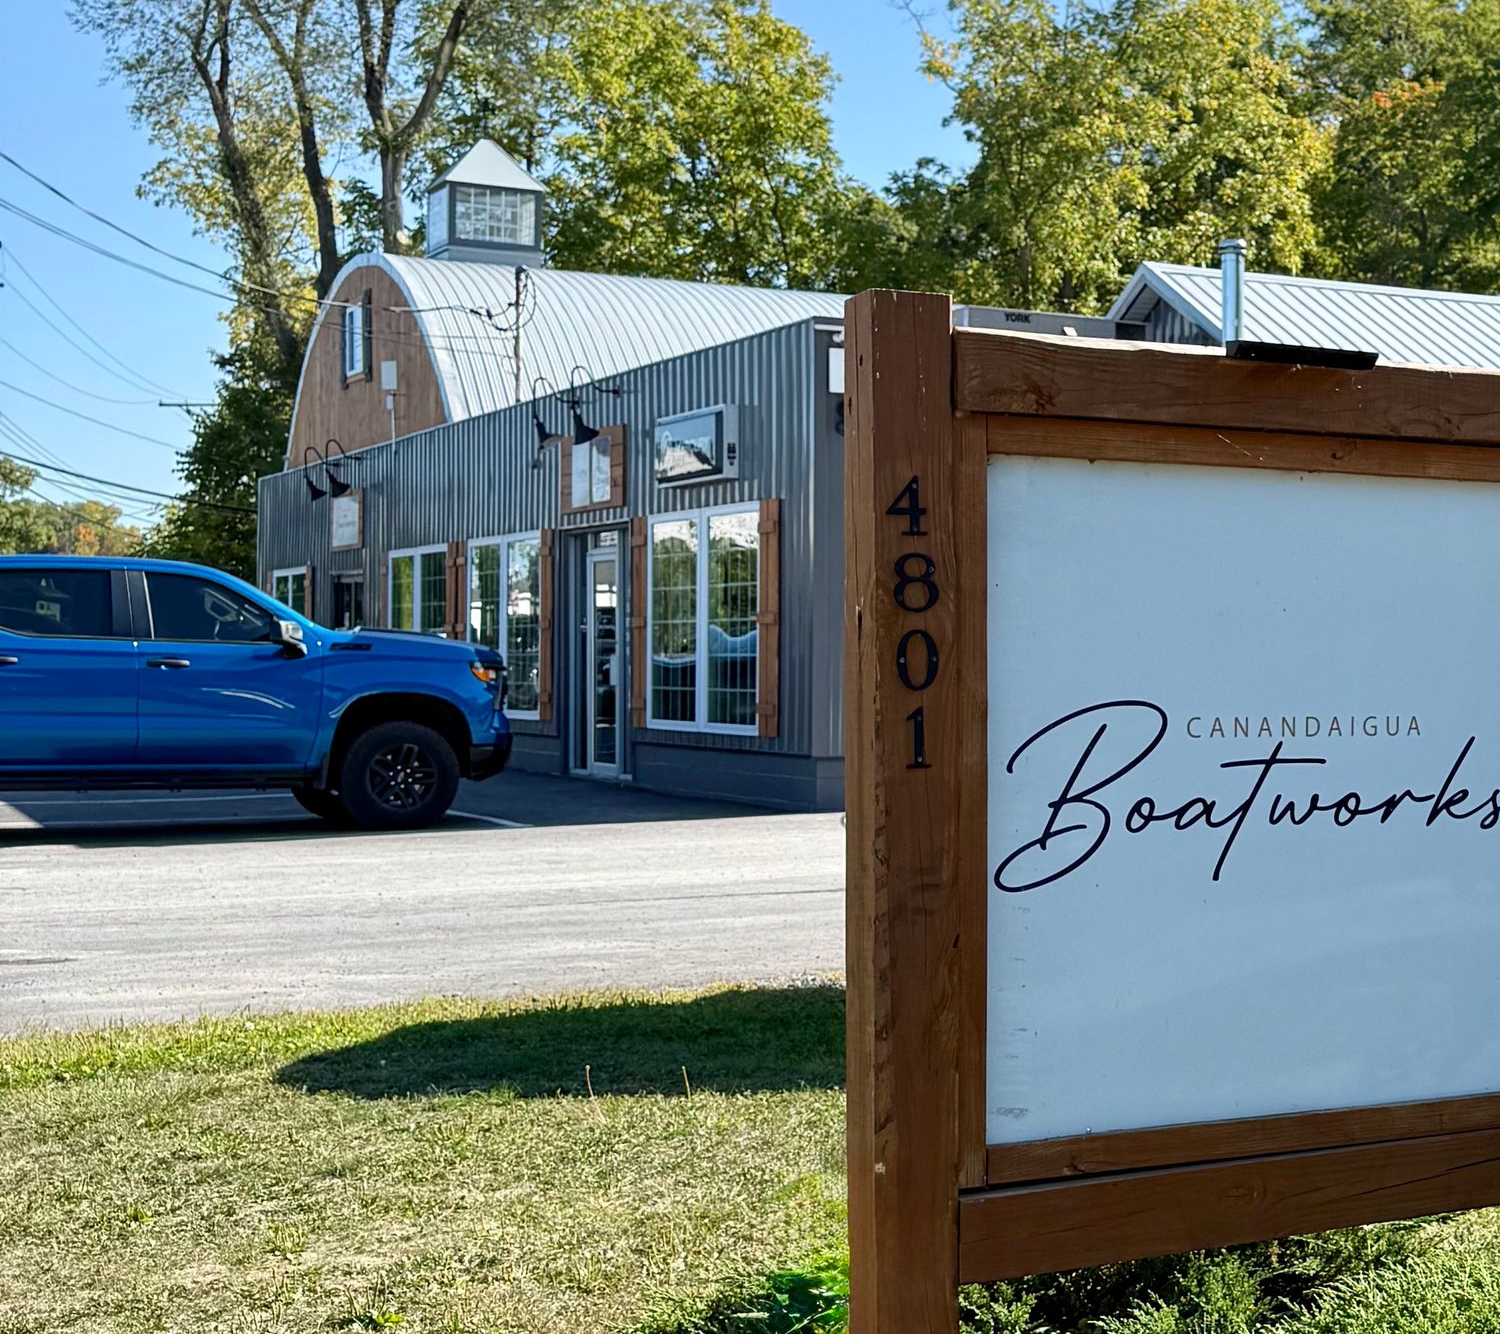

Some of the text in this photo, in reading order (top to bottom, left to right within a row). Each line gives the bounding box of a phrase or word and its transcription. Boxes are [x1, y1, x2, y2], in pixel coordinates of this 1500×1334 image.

[1004, 311, 1031, 324] YORK
[885, 475, 939, 769] 4801
[1186, 715, 1422, 739] CANANDAIGUA
